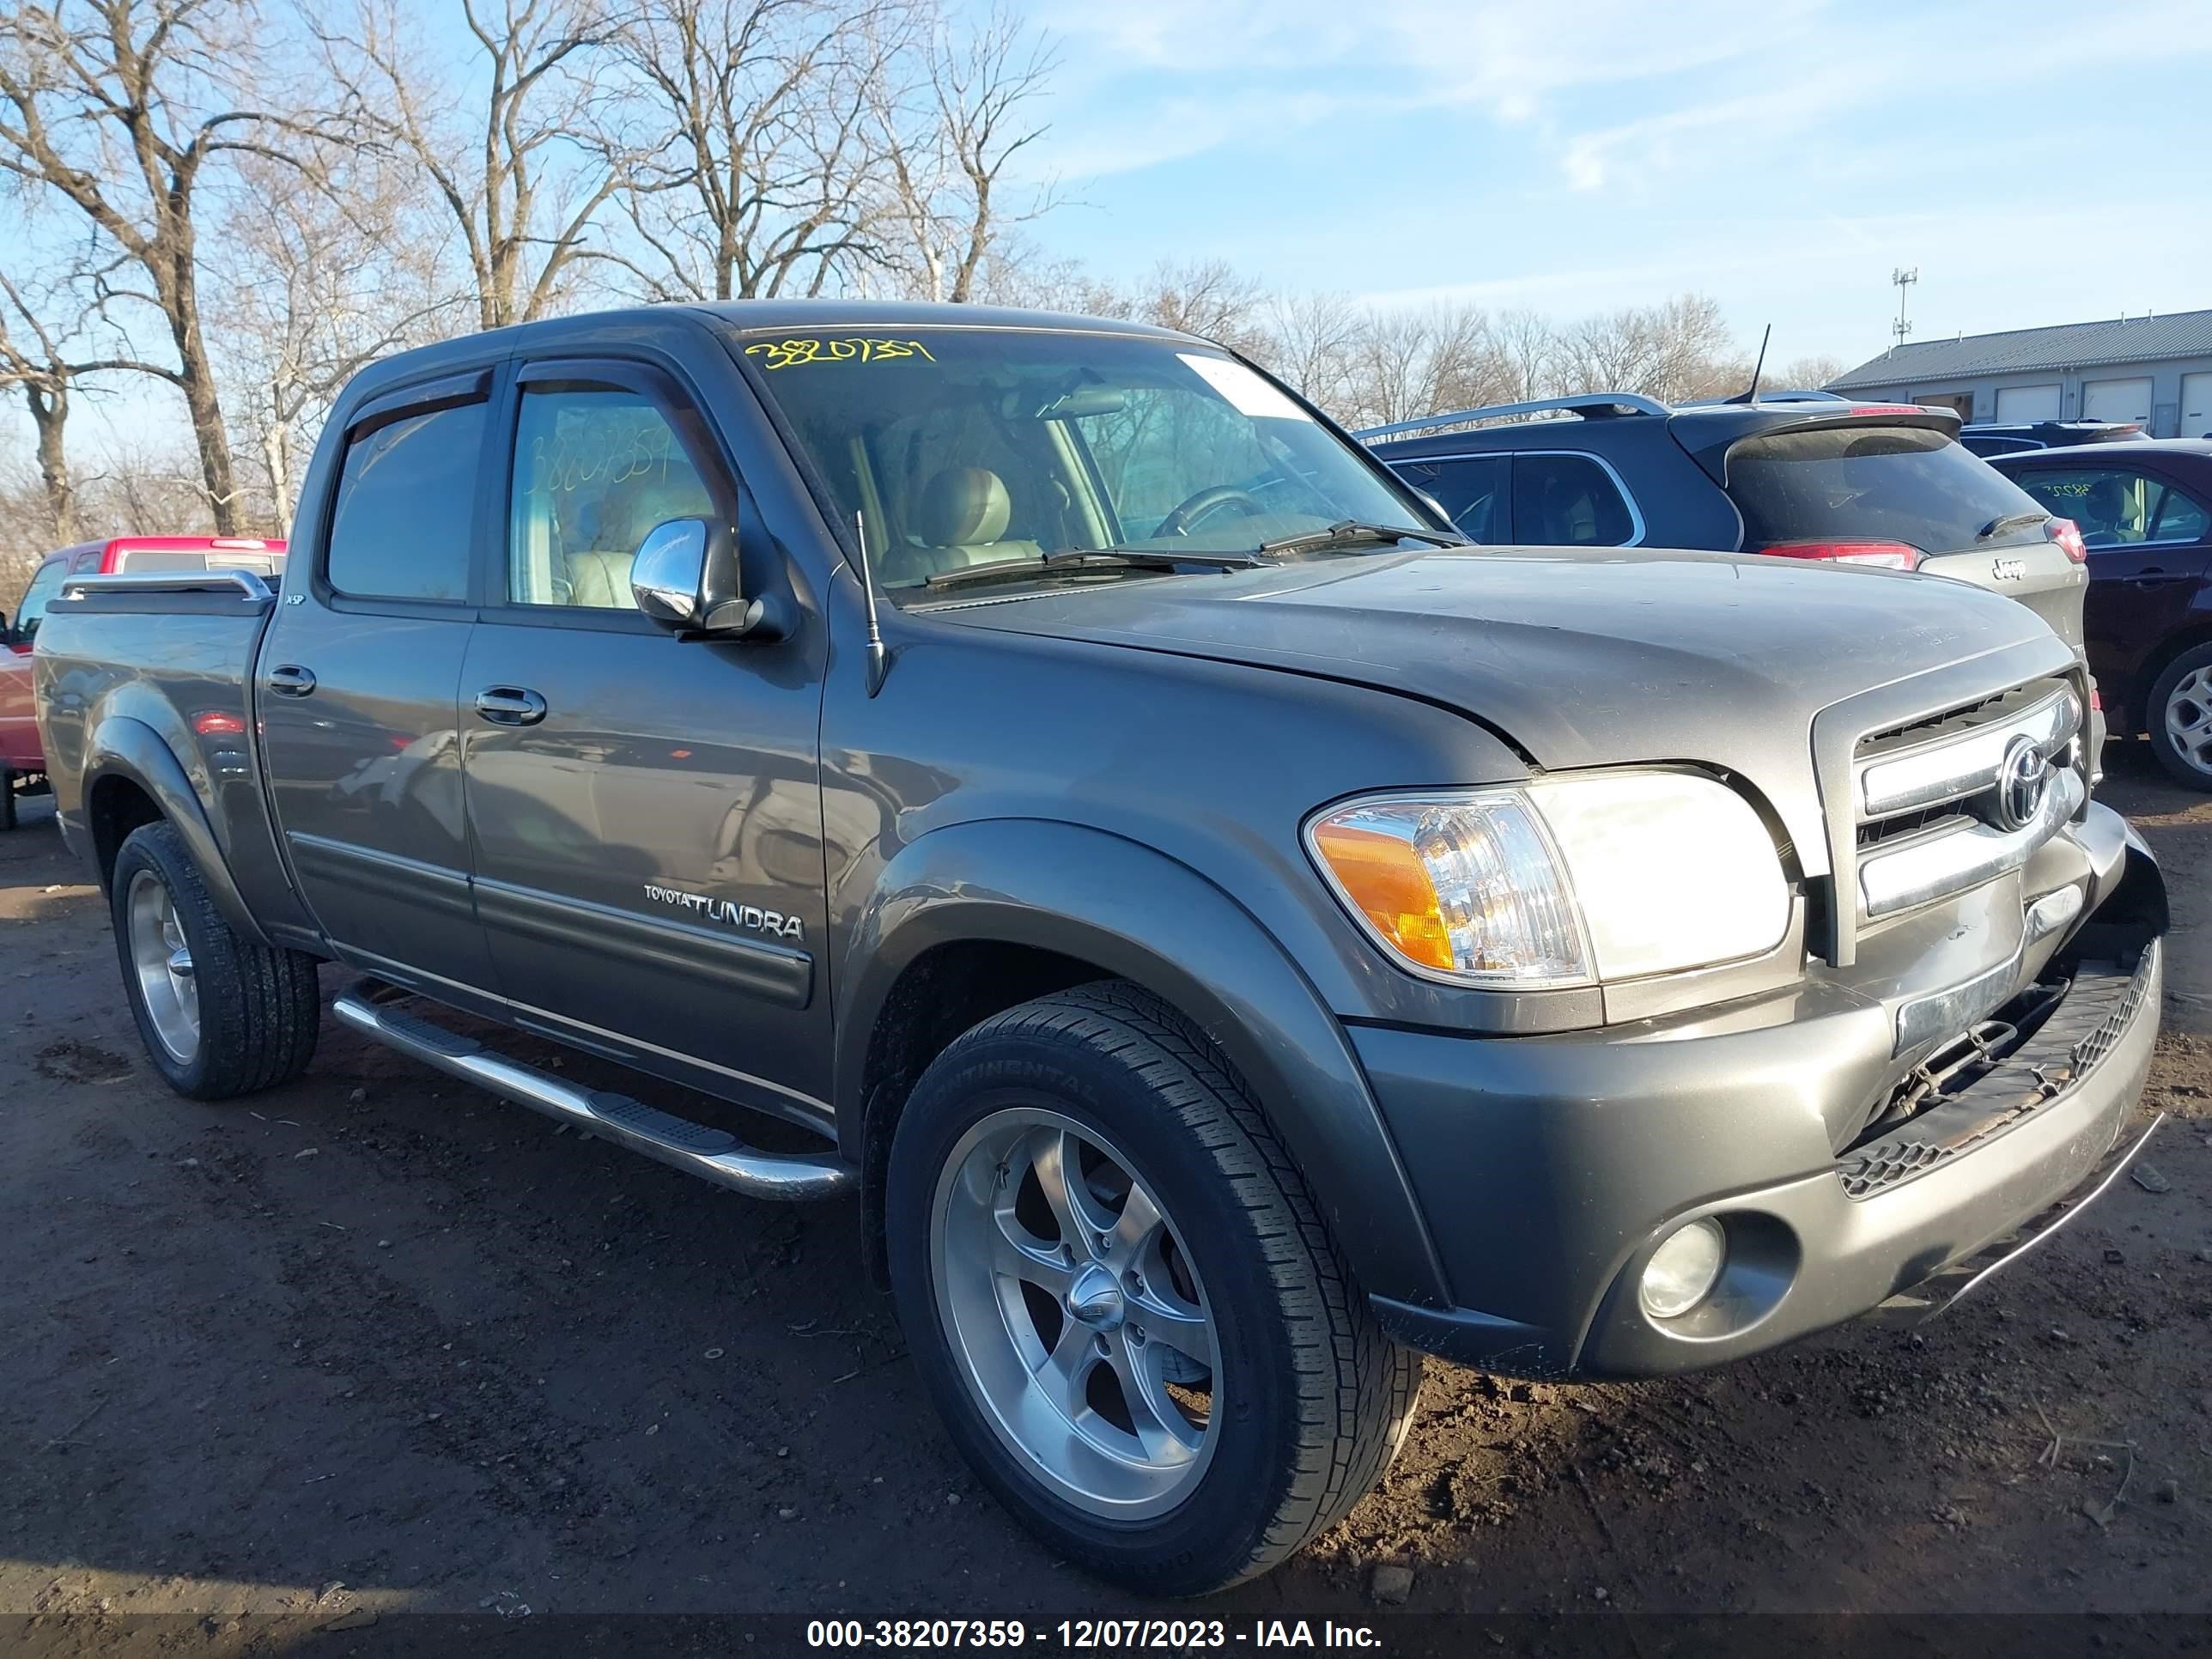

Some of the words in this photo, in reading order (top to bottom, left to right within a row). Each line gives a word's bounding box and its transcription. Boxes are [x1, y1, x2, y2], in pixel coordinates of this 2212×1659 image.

[1992, 558, 2027, 580] Jeep
[644, 884, 691, 908] TOYOTA
[690, 894, 805, 941] TUNDRA
